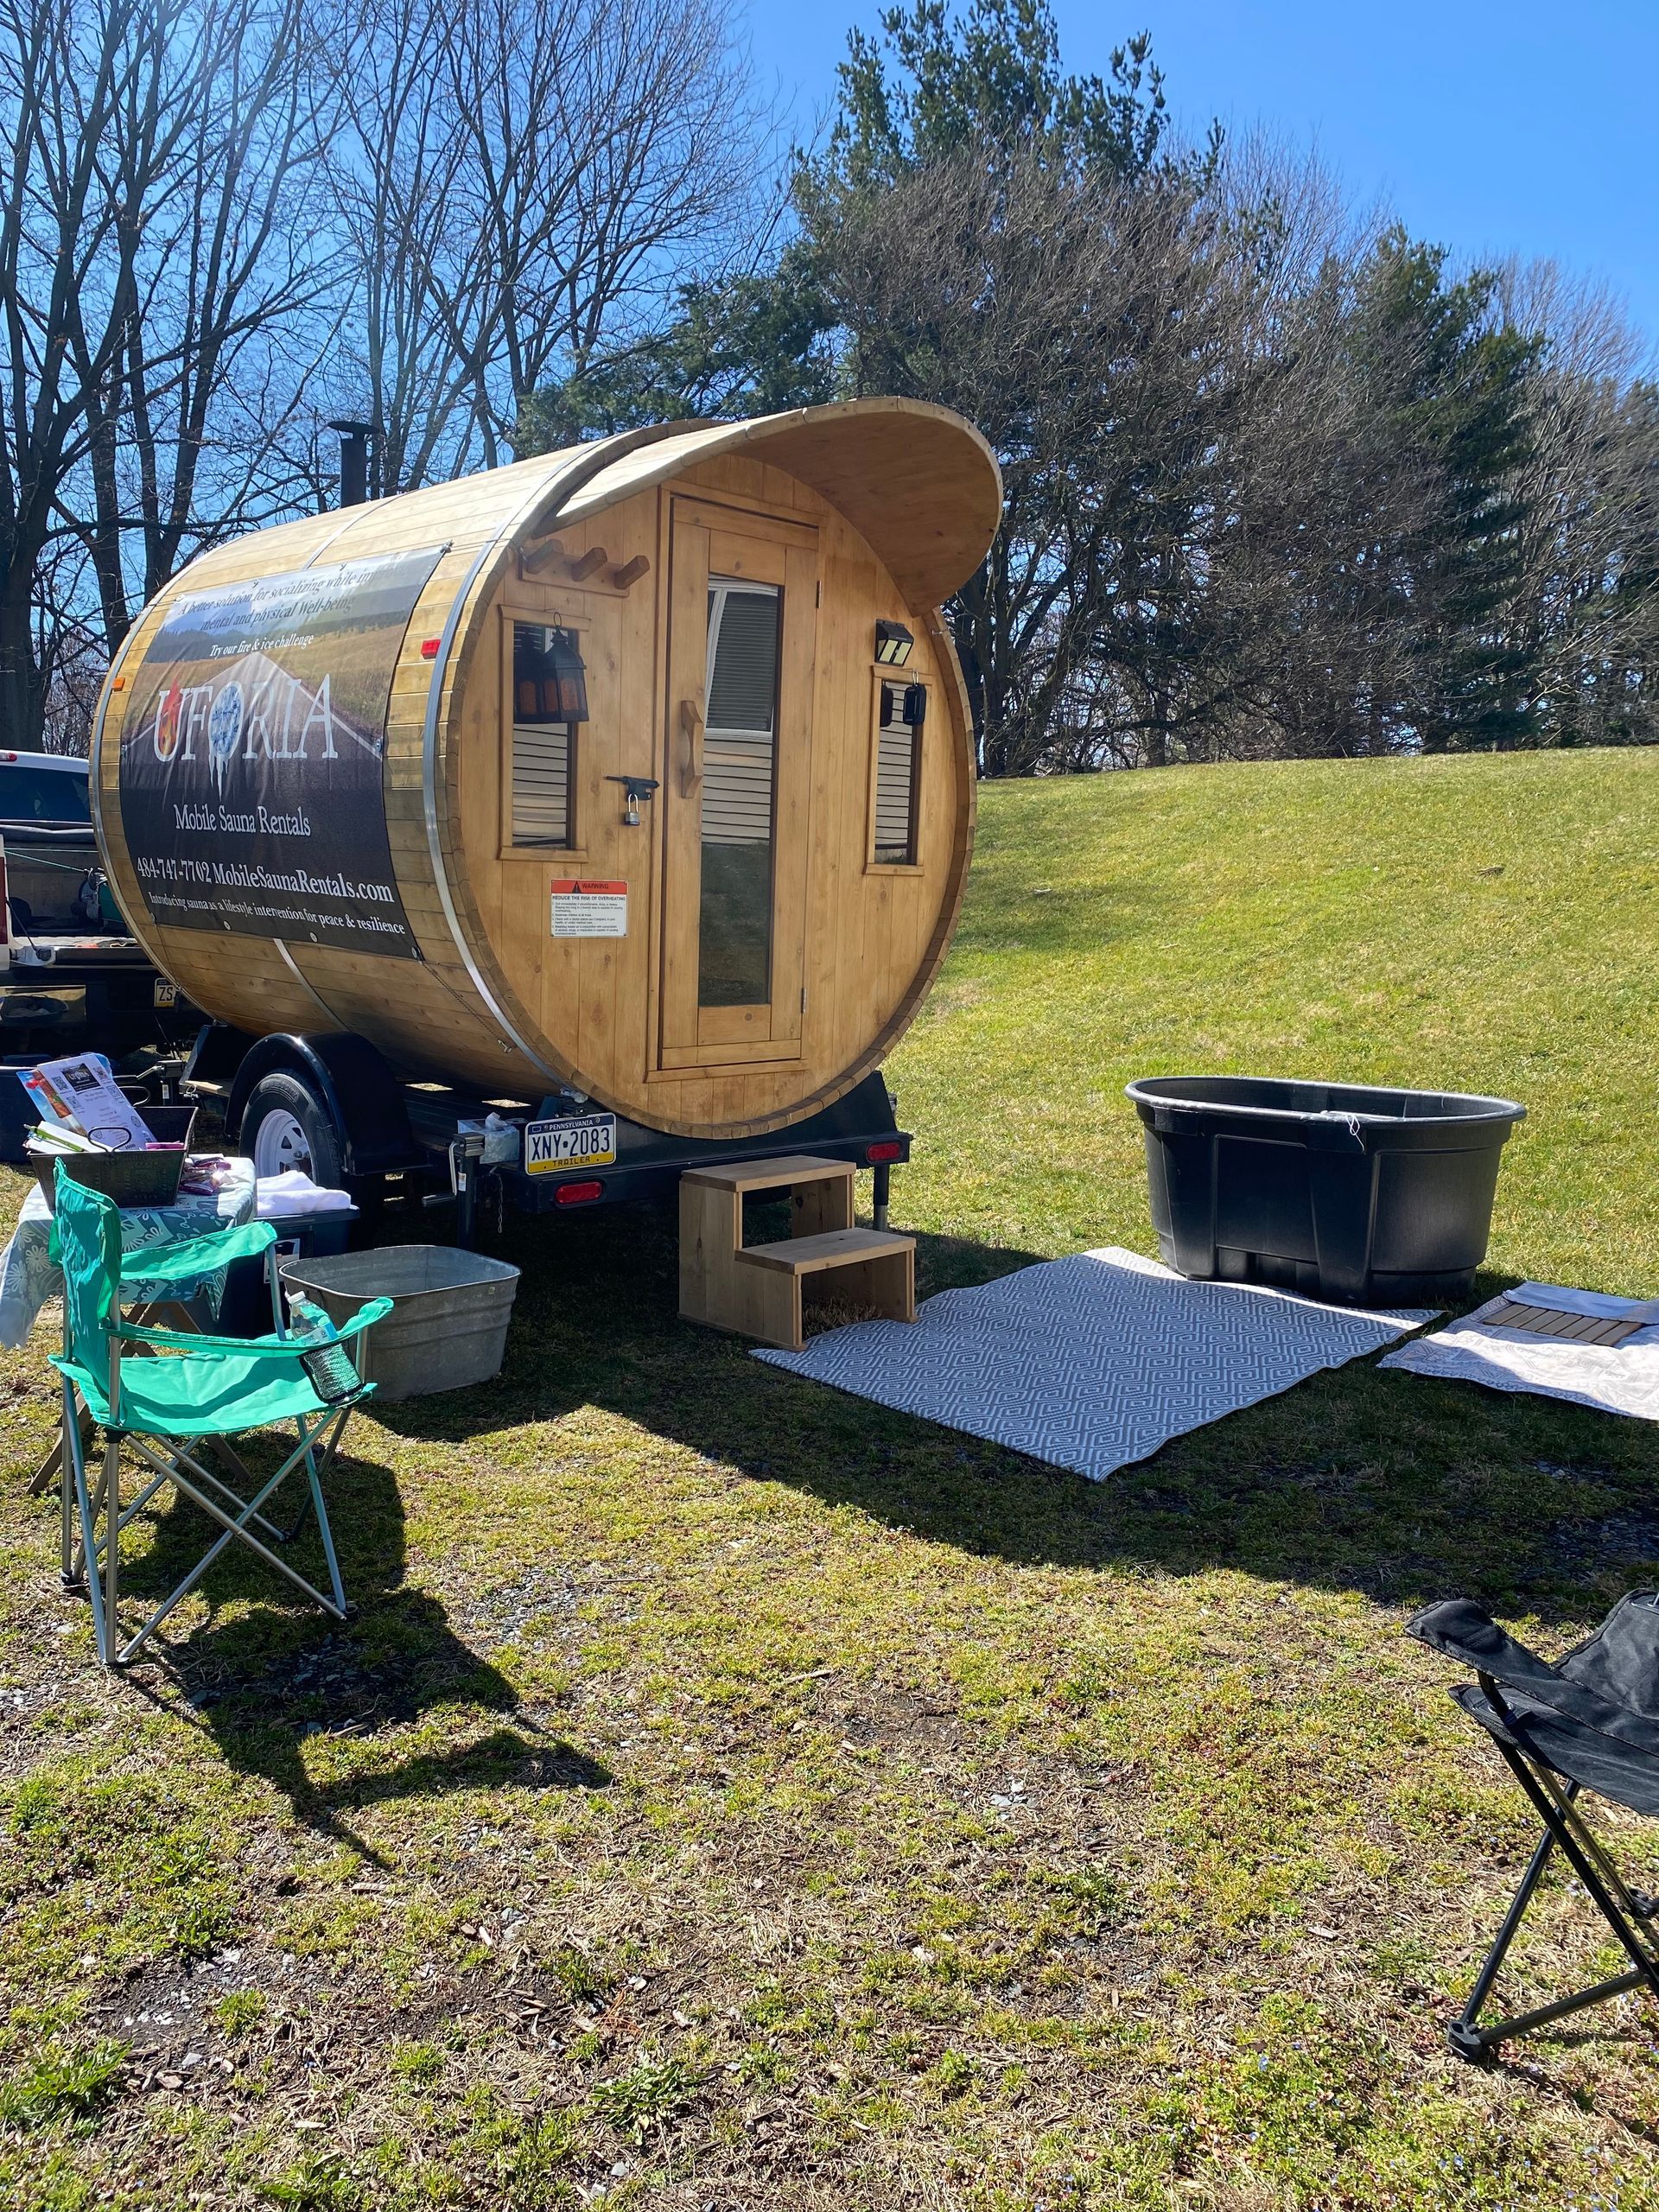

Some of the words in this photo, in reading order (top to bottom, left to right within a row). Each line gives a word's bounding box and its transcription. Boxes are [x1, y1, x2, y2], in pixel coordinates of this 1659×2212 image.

[189, 601, 215, 614] better
[214, 590, 252, 607] solution
[252, 588, 270, 602] for
[270, 579, 325, 596] socializing
[325, 572, 357, 588] while
[200, 613, 234, 631] mental
[232, 609, 254, 624] and
[249, 605, 296, 628] physical
[297, 596, 355, 614] Well-being
[209, 645, 224, 660] Try
[222, 646, 238, 655] our
[237, 640, 252, 653] fire
[251, 639, 260, 653] &
[260, 638, 275, 651] ice
[274, 633, 315, 649] challenge
[154, 673, 339, 783] UFORIA
[173, 803, 217, 831] Mobile
[218, 804, 257, 834] Sauna
[257, 805, 311, 836] Rentals
[137, 856, 213, 885] 484-747-7702
[212, 862, 395, 903] MobileSaunaRentals.com
[148, 891, 188, 912] Introducing
[187, 899, 210, 911] sauna
[207, 902, 218, 912] as
[217, 901, 225, 912] a
[221, 899, 255, 918] lifestyle
[253, 901, 305, 921] intervention
[302, 907, 319, 924] for
[318, 912, 346, 929] peace
[344, 913, 356, 929] &
[356, 916, 406, 936] resilience
[550, 1119, 594, 1131] PENNSYLVANIA
[553, 1155, 590, 1167] TRAILER
